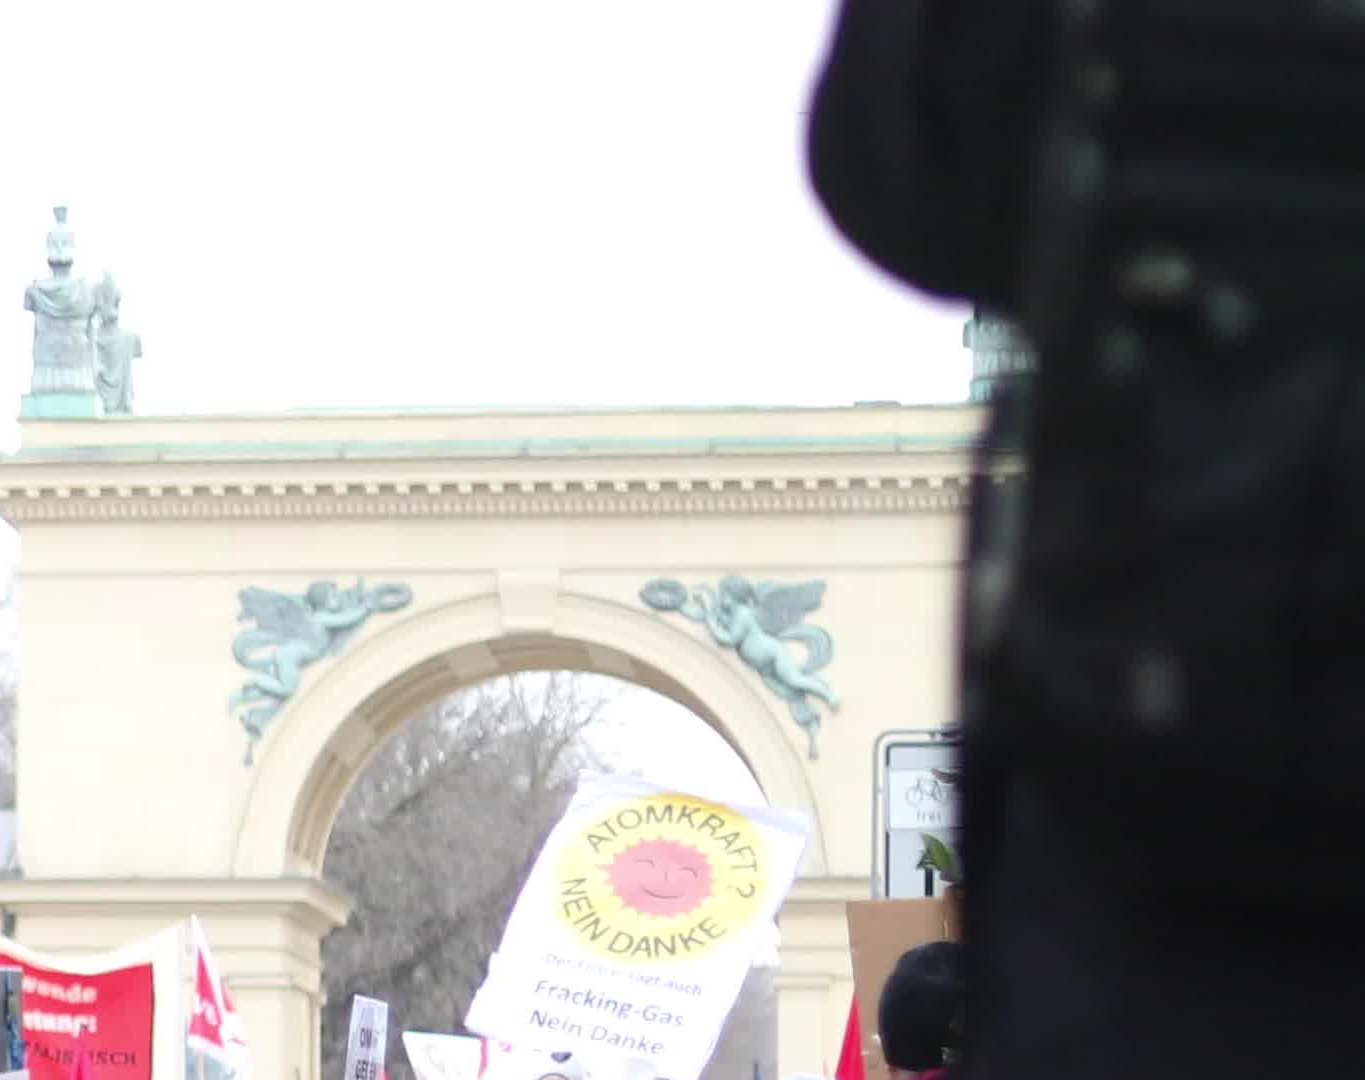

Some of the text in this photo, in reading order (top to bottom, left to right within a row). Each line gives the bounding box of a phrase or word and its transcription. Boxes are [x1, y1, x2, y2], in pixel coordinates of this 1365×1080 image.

[561, 877, 729, 959] NEIN DANKE
[535, 980, 685, 1027] Fracking-Gas
[530, 1009, 665, 1055] Nein Danke
